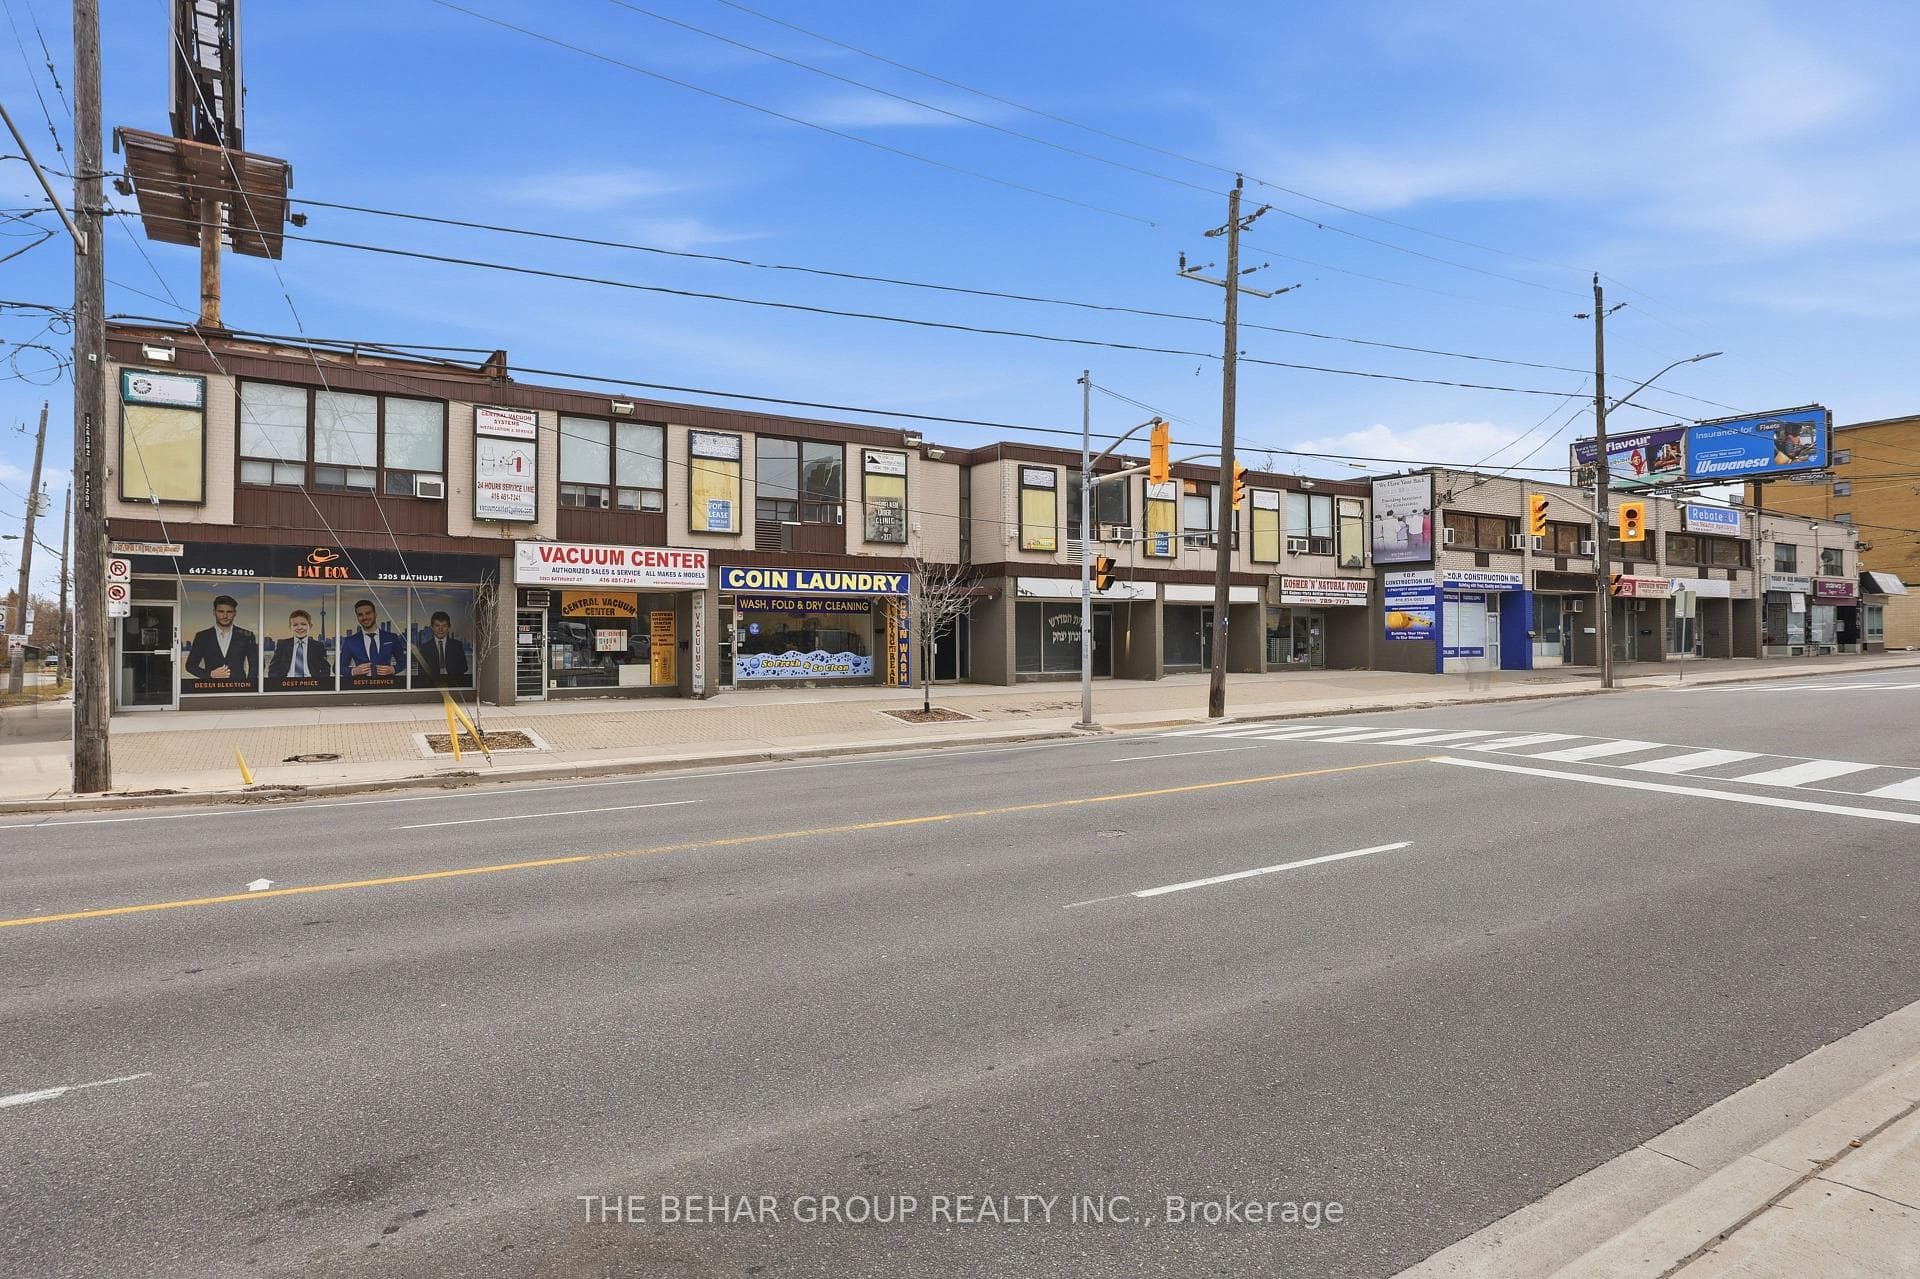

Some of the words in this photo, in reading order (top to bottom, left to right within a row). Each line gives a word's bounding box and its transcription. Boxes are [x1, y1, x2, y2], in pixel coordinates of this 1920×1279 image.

[481, 410, 507, 419] CENTRAL
[1695, 429, 1739, 440] Insurance
[1759, 423, 1781, 431] Fleets
[1605, 435, 1651, 453] flavour
[1695, 456, 1770, 474] Wawanesa
[477, 481, 484, 489] 24
[484, 482, 502, 491] HOURS
[502, 483, 522, 493] SERVICE
[709, 502, 722, 510] FOR
[708, 511, 729, 519] LEASE
[875, 517, 896, 525] CLINIC
[538, 546, 625, 566] VACUUM
[631, 550, 706, 569] CENTER
[297, 565, 320, 578] HAT
[324, 566, 349, 579] BOX
[400, 573, 444, 582] BATHURST
[551, 566, 590, 575] AUTHORIZED
[591, 568, 610, 576] SALES
[611, 568, 616, 576] &
[616, 569, 641, 577] SERVICE
[1463, 573, 1509, 581] CONSTRUCTION
[728, 569, 788, 589] COIN
[795, 571, 904, 592] LAUNDRY
[1283, 578, 1309, 589] KOSHER
[1318, 580, 1345, 591] NATURAL
[1346, 581, 1366, 592] FOODS
[562, 597, 599, 615] CENTRAL
[602, 597, 637, 615] VACUUM
[584, 607, 616, 616] CENTER
[740, 599, 769, 610] WASH,
[771, 600, 795, 610] FOLD
[797, 600, 803, 610] &
[805, 600, 823, 611] DRY
[824, 601, 869, 611] CLEANING
[760, 659, 774, 669] So
[774, 659, 801, 668] Fresh
[802, 661, 812, 670] &
[812, 664, 824, 673] So
[824, 664, 850, 672] Clean
[899, 642, 908, 683] WASH
